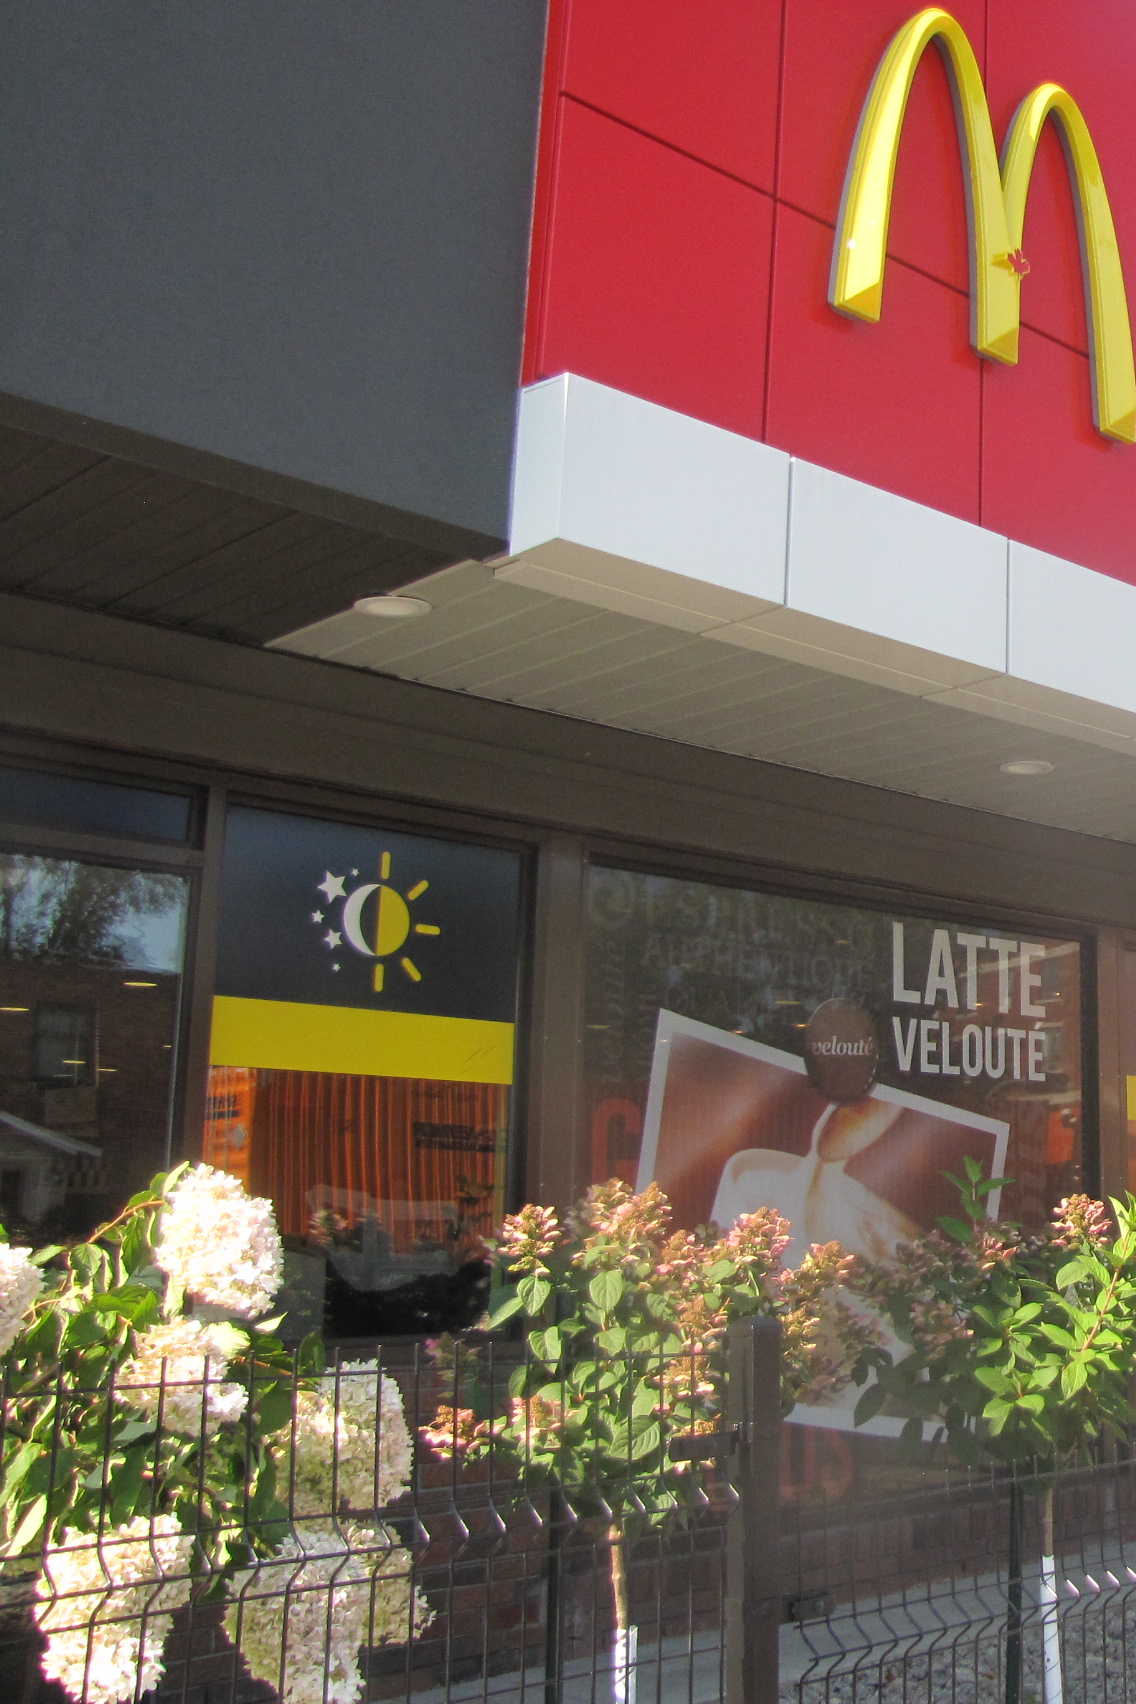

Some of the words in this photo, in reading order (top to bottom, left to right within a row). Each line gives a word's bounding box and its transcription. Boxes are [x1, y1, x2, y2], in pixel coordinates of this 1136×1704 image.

[892, 922, 1046, 1017] LATTE
[811, 1035, 874, 1057] velouté
[892, 1016, 1046, 1081] VELOUTÉ
